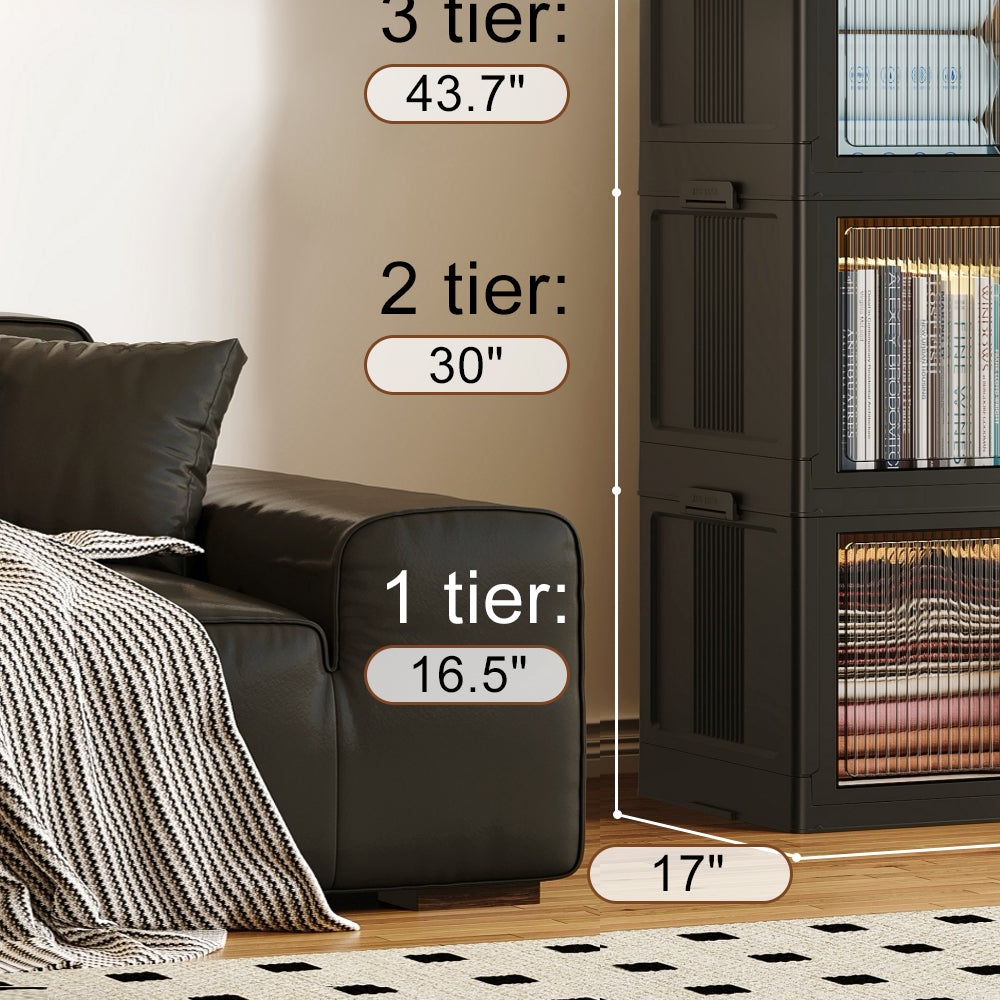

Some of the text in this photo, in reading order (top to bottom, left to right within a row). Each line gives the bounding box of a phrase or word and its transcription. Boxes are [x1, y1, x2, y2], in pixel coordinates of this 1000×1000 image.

[887, 272, 901, 347] ALEXEY
[953, 321, 968, 465] FINE WINES
